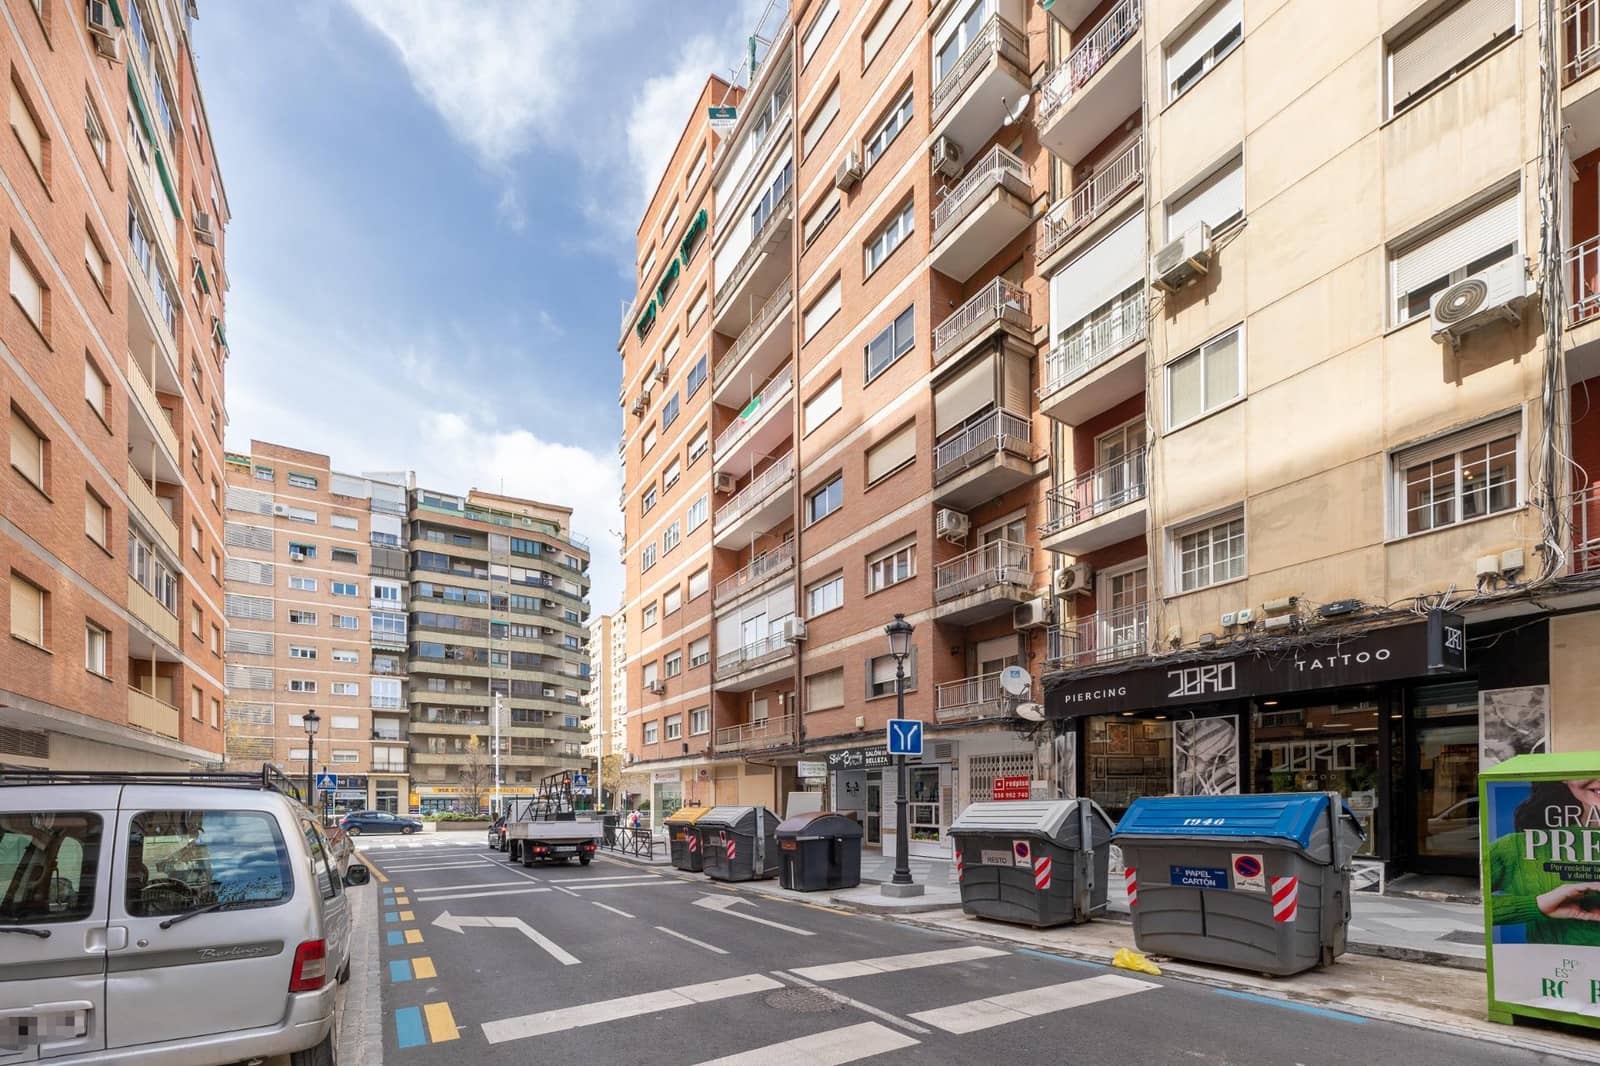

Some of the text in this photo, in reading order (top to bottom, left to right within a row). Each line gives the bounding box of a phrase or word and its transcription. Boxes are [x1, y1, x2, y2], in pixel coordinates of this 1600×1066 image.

[1064, 649, 1391, 703] PIERCING ZERO TATTOO
[1183, 818, 1225, 826] 1946
[1185, 869, 1211, 878] PAPEL
[1182, 877, 1216, 887] CARTÓN
